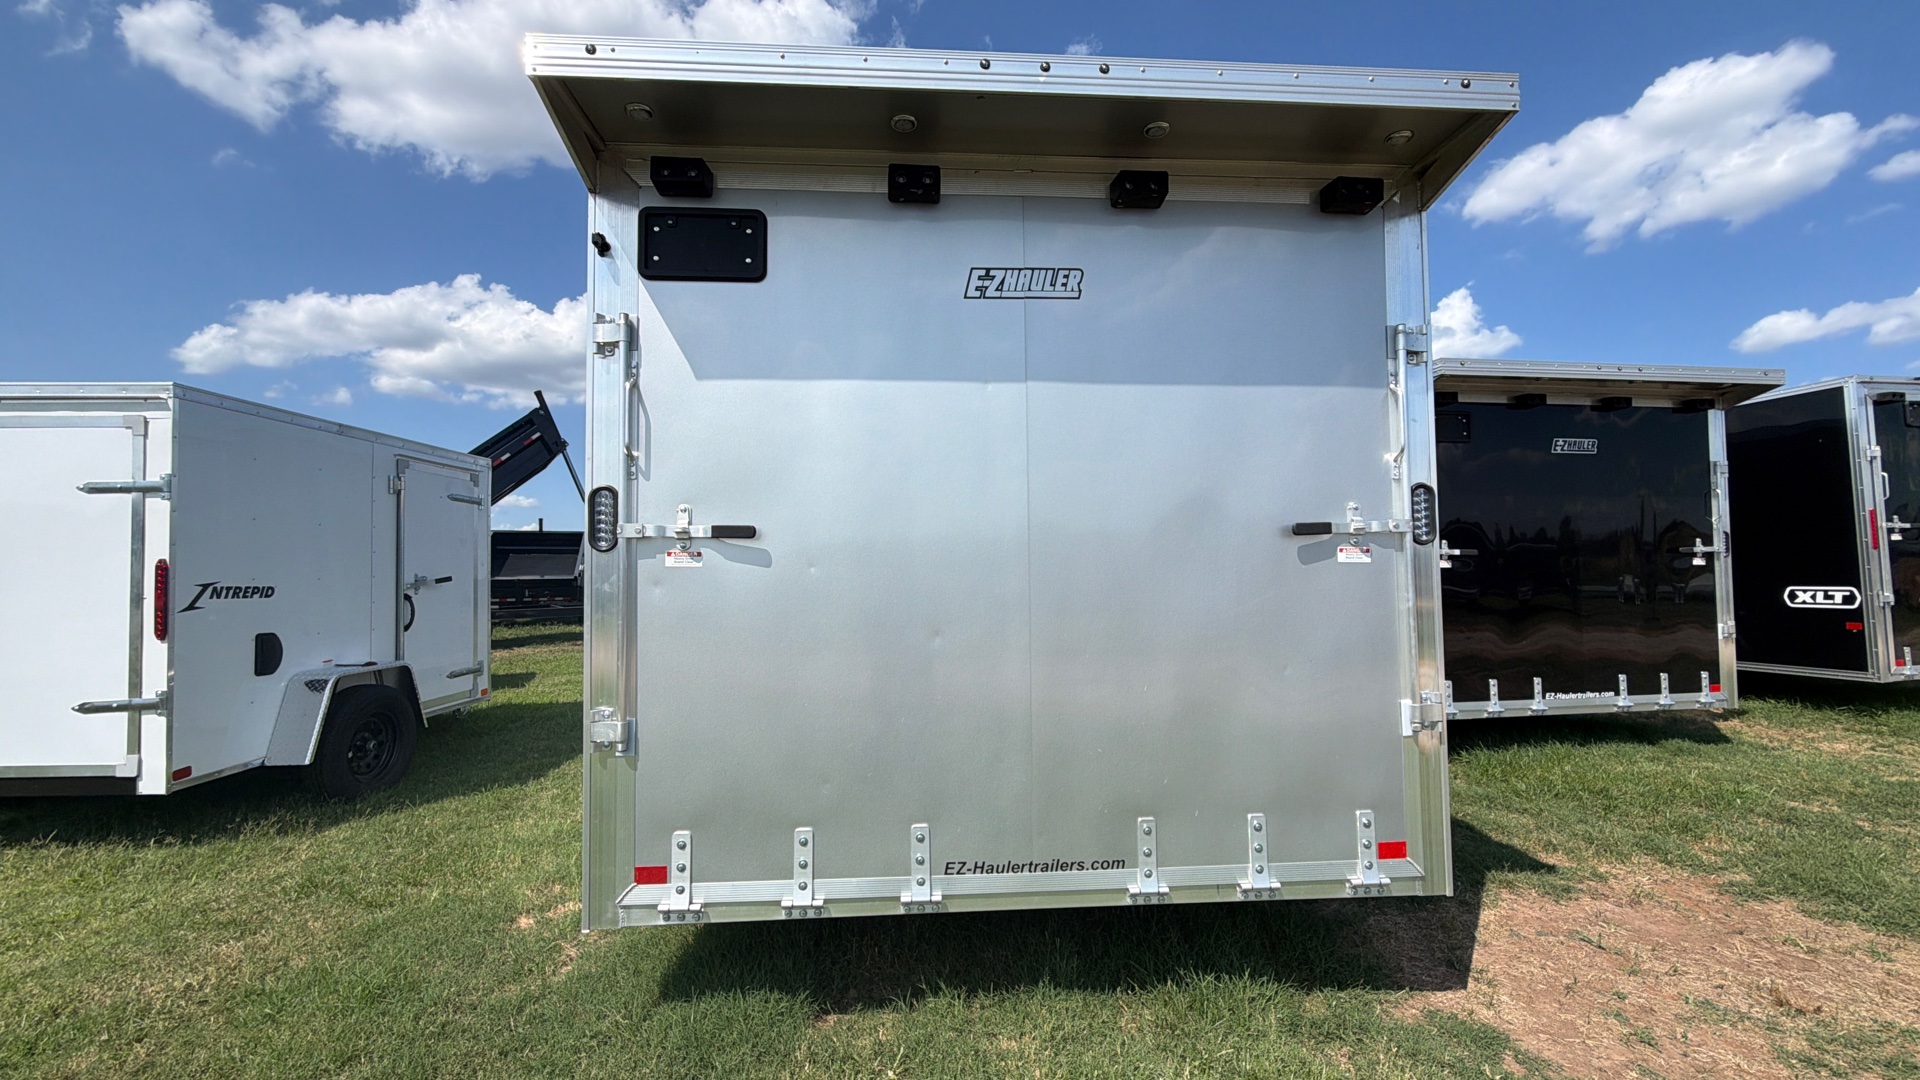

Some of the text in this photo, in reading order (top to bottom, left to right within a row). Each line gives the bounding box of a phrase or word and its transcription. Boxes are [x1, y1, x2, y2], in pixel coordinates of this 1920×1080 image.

[176, 581, 276, 614] INTREPID
[1794, 591, 1851, 604] XLT
[1545, 691, 1615, 700] EZ-Haulertrailers.com
[943, 858, 1126, 876] EZ-Haulertrailers.com
